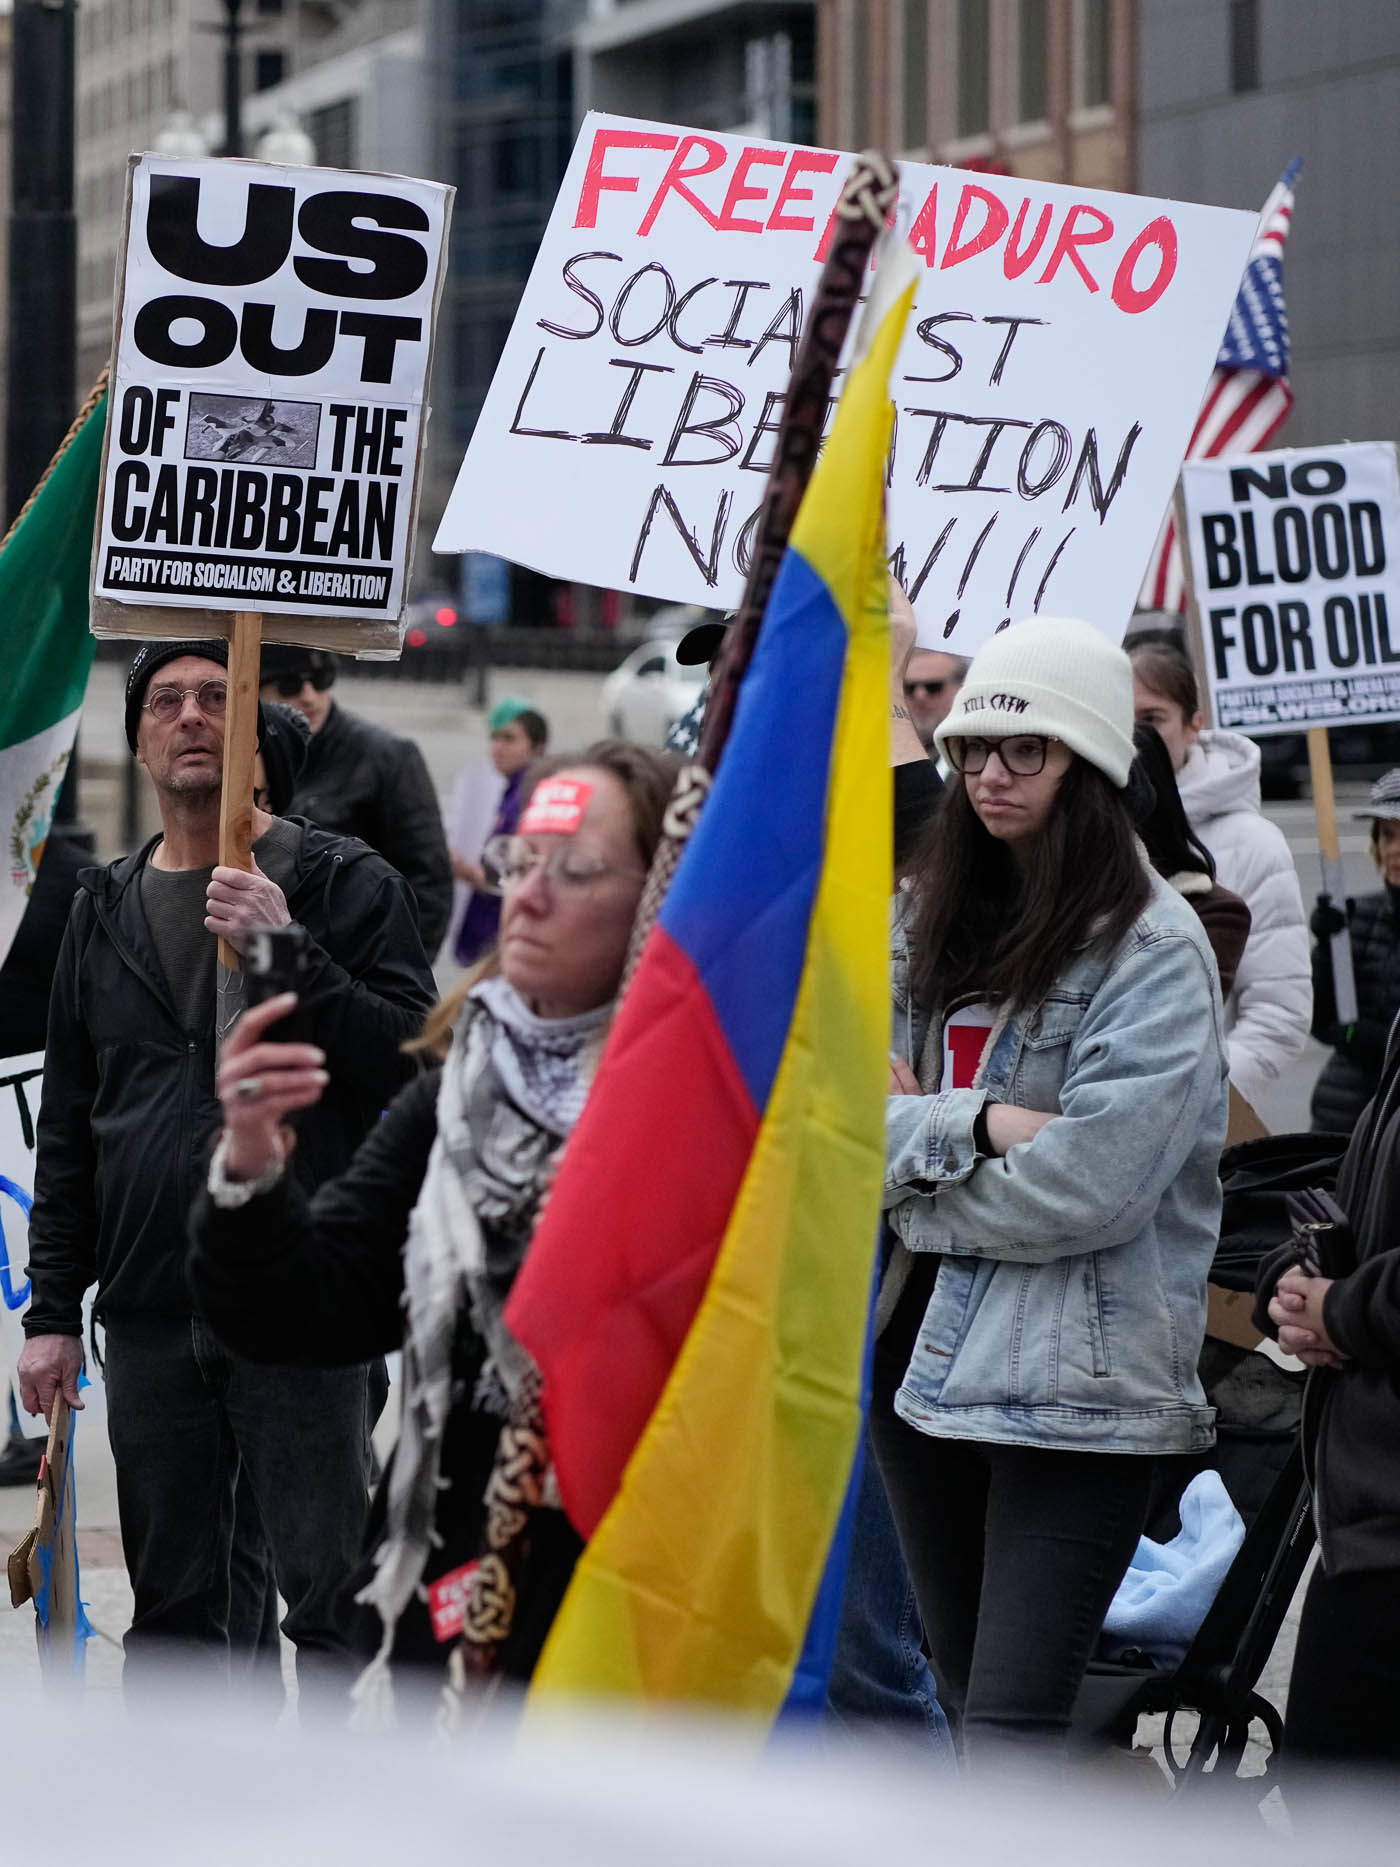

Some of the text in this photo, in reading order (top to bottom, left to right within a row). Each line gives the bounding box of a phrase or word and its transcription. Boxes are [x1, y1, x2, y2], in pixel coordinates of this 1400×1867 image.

[572, 129, 840, 236] FREE
[146, 174, 430, 300] US
[134, 295, 423, 384] OUT
[537, 251, 1053, 387] SOCIAST
[119, 385, 407, 477] OF THE
[510, 346, 1143, 525] LIBETION
[110, 461, 399, 561] CARIBBEAN
[1229, 460, 1347, 502] NO
[108, 556, 387, 600] PARTY FOR SOCIALISM & LIBERATION
[1202, 501, 1387, 590] BLOOD
[1209, 593, 1400, 680] FOR OIL
